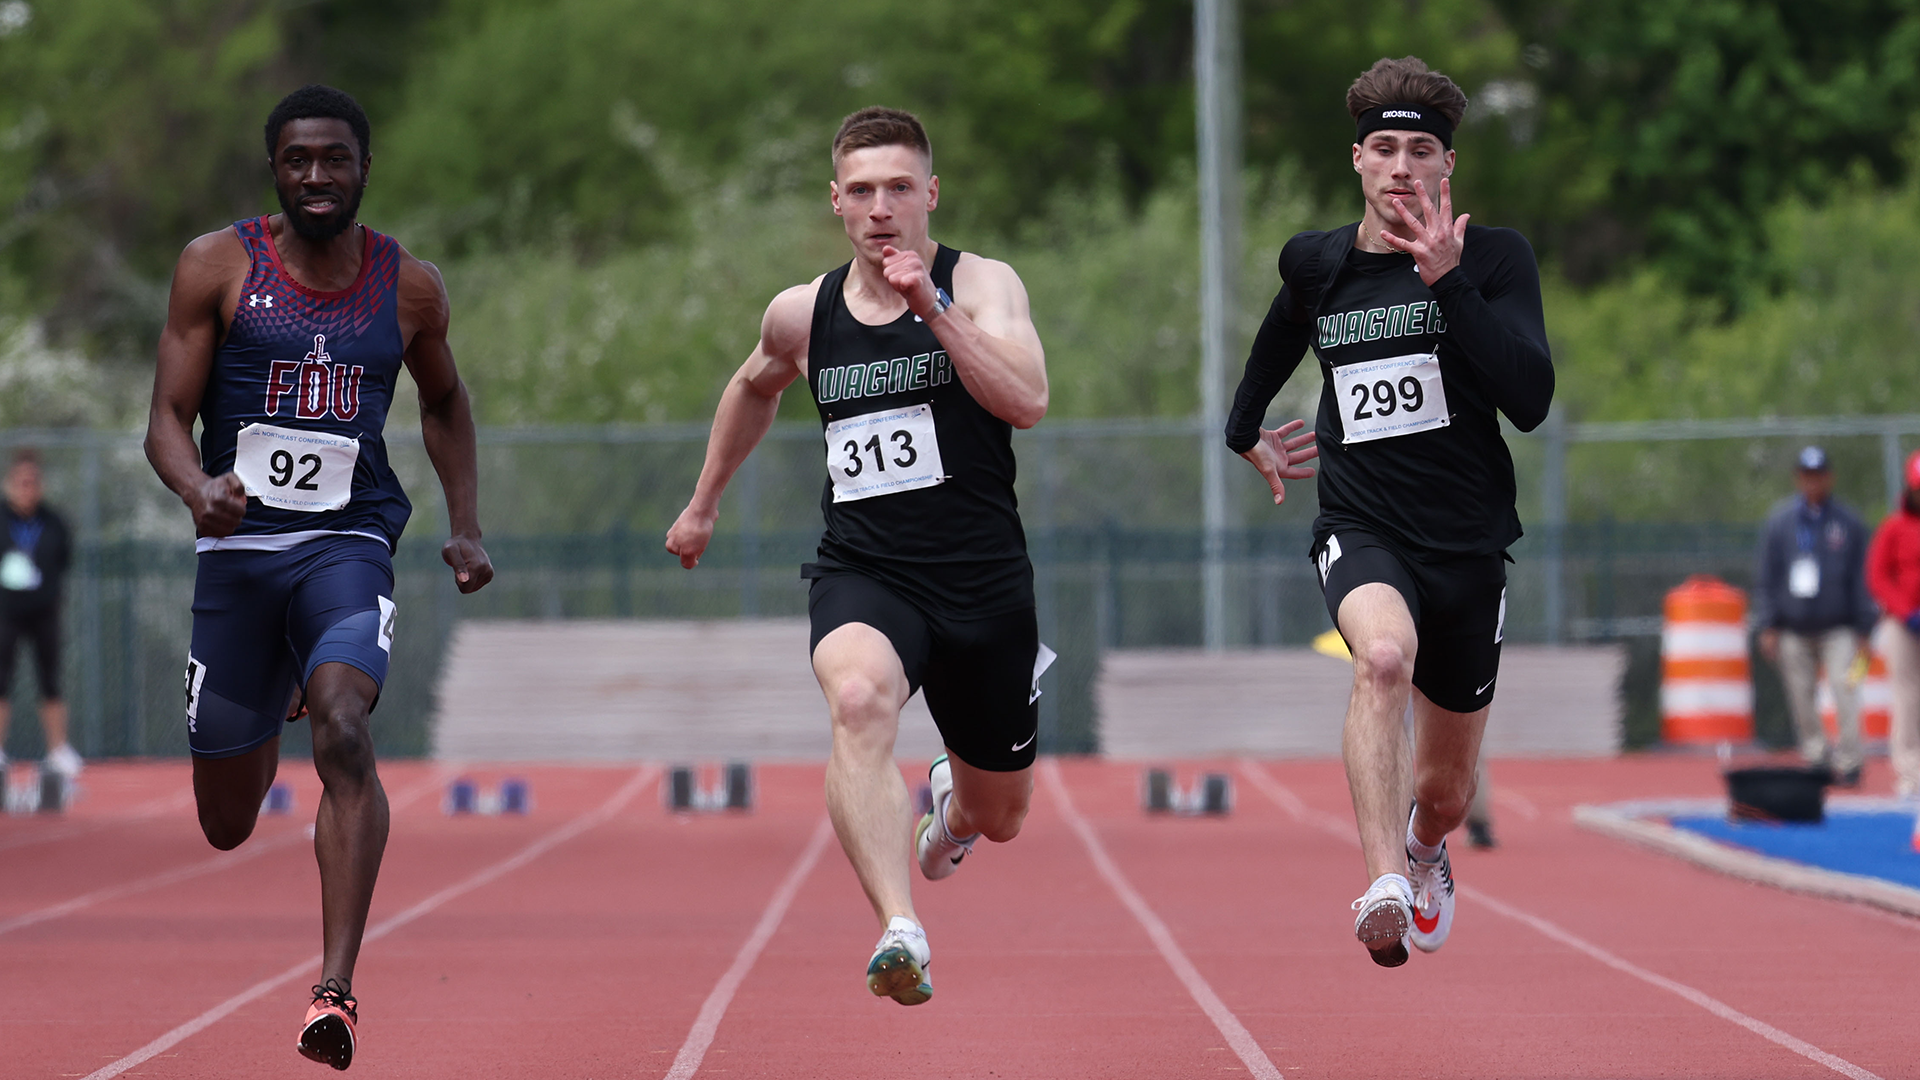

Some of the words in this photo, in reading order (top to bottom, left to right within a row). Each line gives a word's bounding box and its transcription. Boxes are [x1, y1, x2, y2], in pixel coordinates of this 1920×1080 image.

[1382, 110, 1421, 120] EXOSKLTN
[1317, 300, 1447, 349] WAGNER
[1380, 360, 1416, 371] CONFERENCE
[818, 350, 952, 404] WAGNER
[265, 359, 364, 422] FDU
[1351, 376, 1424, 421] 299
[841, 420, 868, 431] NORTHEAST
[869, 412, 909, 426] CONFERENCE
[1367, 426, 1383, 435] TRACK
[1388, 423, 1402, 431] FIELD
[261, 431, 297, 442] NORTHEAST
[299, 436, 338, 446] CONFERENCE
[843, 430, 917, 478] 313
[268, 450, 322, 490] 92
[859, 484, 875, 493] TRACK
[880, 480, 896, 488] FIELD
[896, 474, 934, 486] CHAMPIONSHIP
[265, 494, 283, 503] TRACK
[304, 500, 335, 508] CHAMPION
